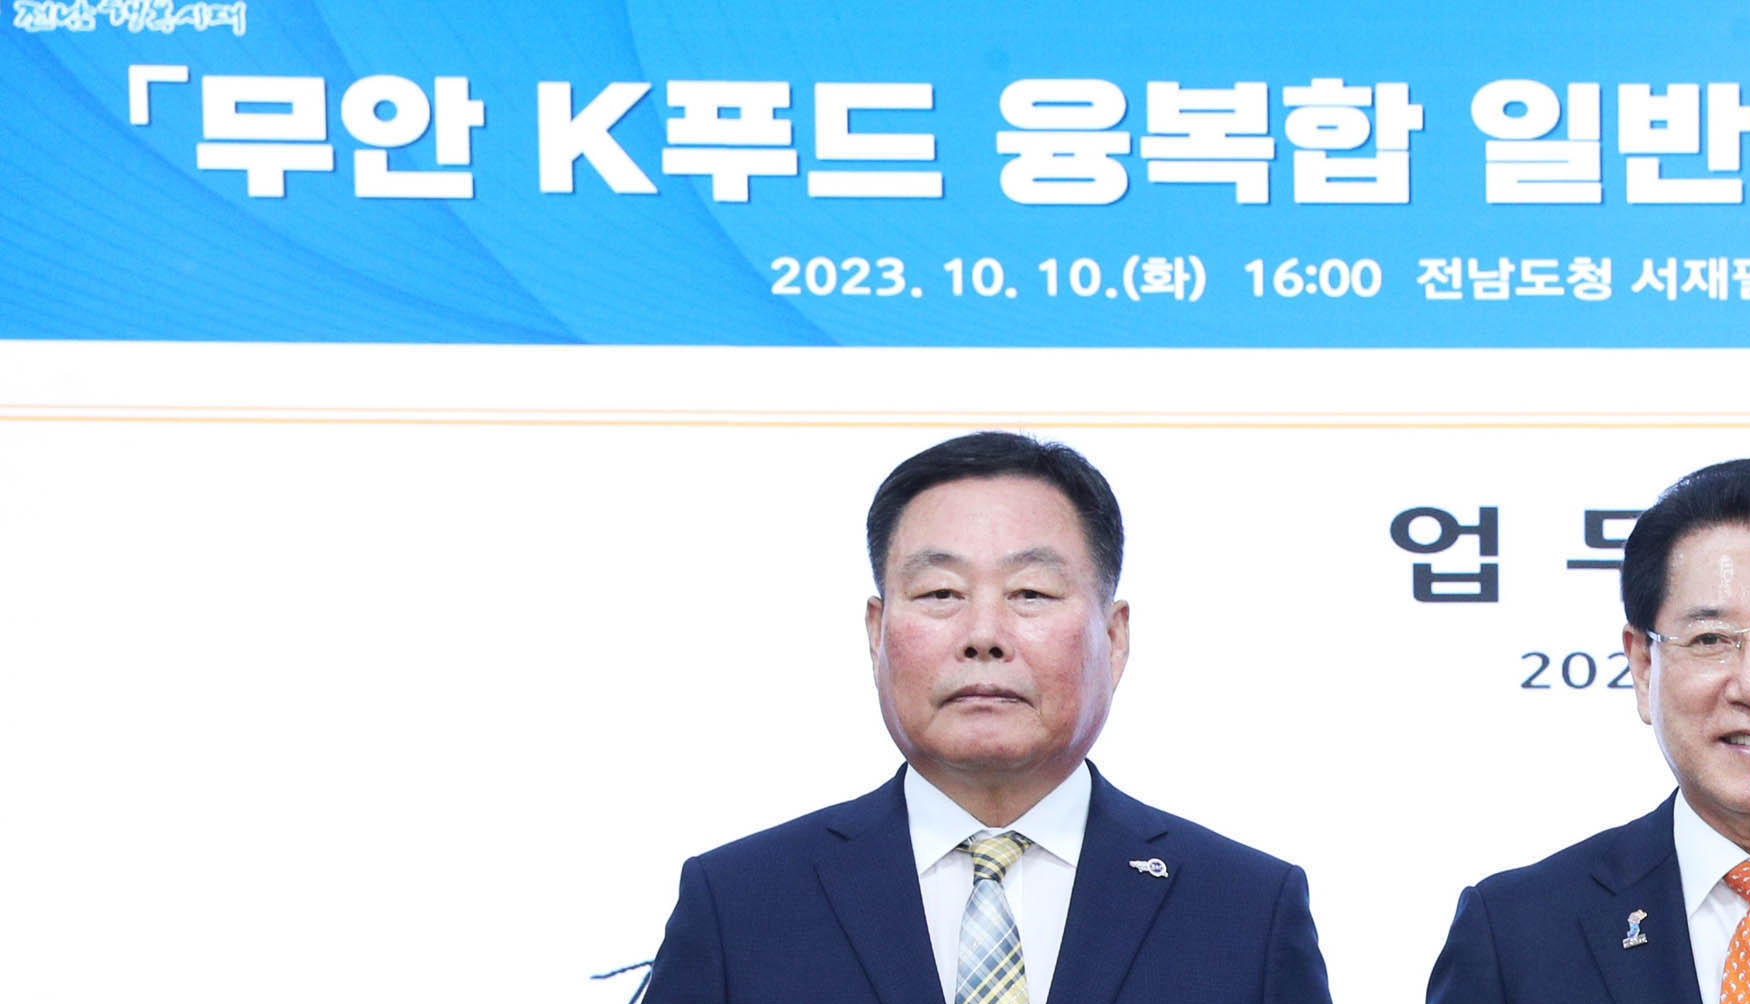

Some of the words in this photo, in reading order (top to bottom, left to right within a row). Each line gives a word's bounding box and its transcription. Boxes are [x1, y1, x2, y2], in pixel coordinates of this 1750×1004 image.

[537, 80, 943, 203] K푸드
[996, 78, 1424, 206] 융복합
[771, 256, 924, 298] 2023.
[943, 257, 1018, 298] 10.
[1244, 257, 1383, 298] 16:00
[1416, 256, 1613, 302] 전남도청
